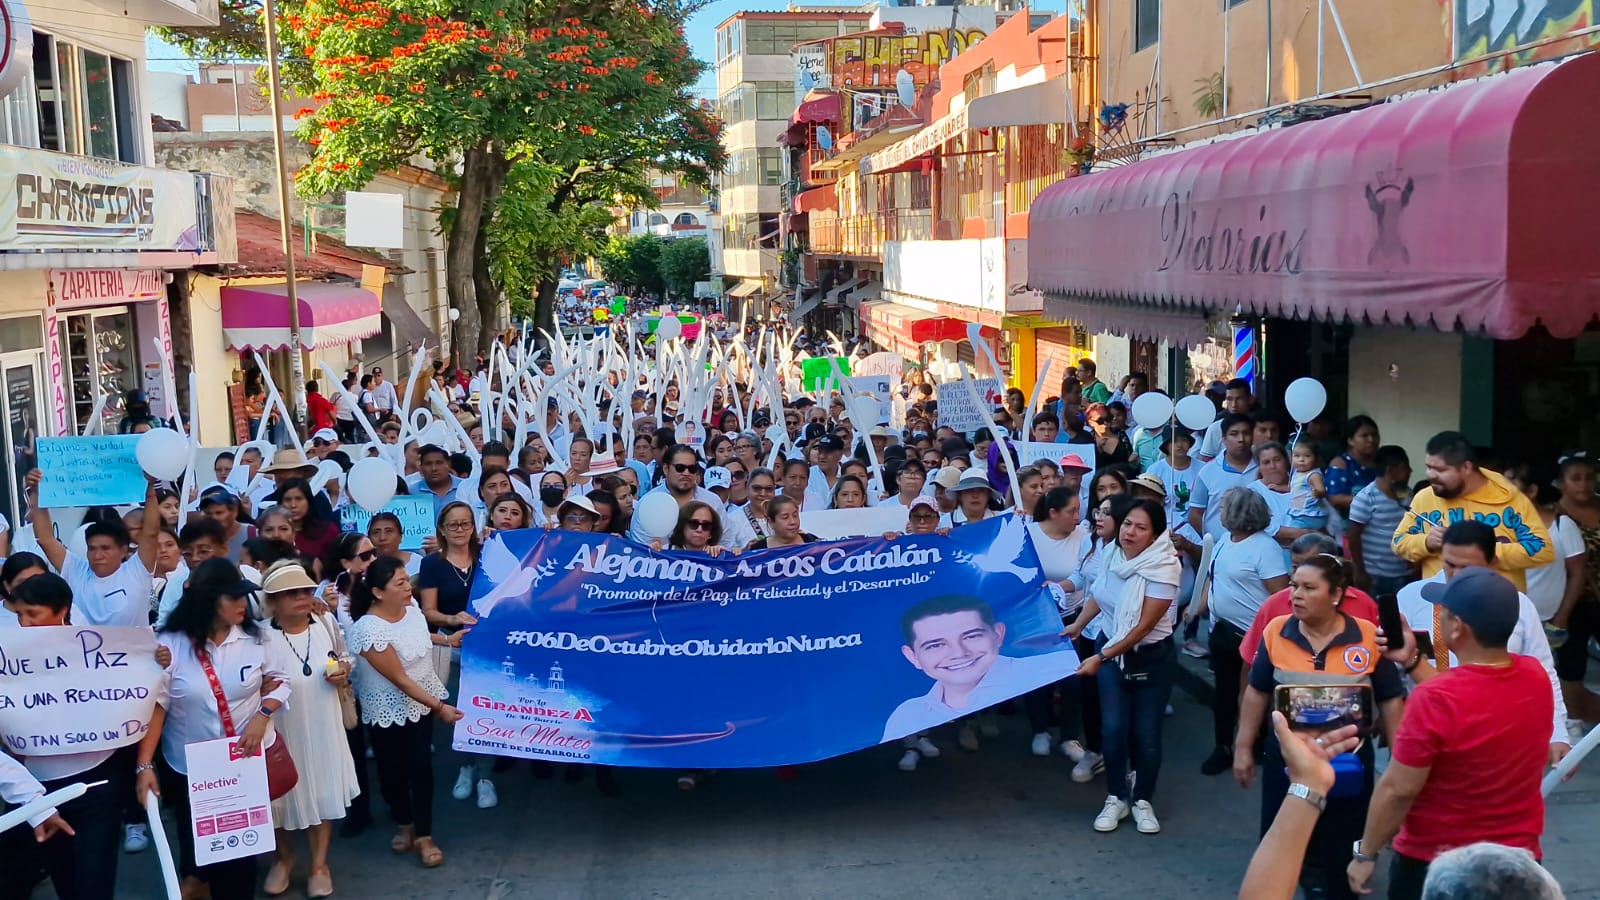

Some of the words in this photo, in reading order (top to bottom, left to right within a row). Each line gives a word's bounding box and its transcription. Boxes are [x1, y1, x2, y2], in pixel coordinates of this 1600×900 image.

[939, 112, 965, 140] JUAREZ
[17, 173, 154, 224] CHAMPIONS
[60, 271, 124, 301] ZAPATERIA
[55, 473, 65, 482] la
[709, 470, 722, 480] NY
[64, 488, 75, 497] la
[414, 501, 427, 516] la
[820, 543, 942, 575] Catalán
[664, 586, 681, 601] de
[683, 586, 698, 601] la
[701, 588, 733, 606] Paz,
[736, 587, 751, 601] la
[752, 583, 822, 600] Felicidad
[822, 586, 834, 600] y
[835, 580, 849, 593] el
[849, 570, 936, 592] Desarrollo"
[506, 630, 862, 657] #06DeOctubreOlvidarloNunca
[46, 655, 68, 670] LA
[24, 692, 58, 709] UNA
[64, 686, 149, 704] REALIDAD
[472, 695, 594, 722] GRANDEZA
[6, 734, 27, 750] NO
[30, 734, 60, 748] TAN
[65, 731, 98, 744] SOLO
[103, 730, 119, 741] UN
[467, 717, 514, 739] San
[520, 722, 592, 750] Mateo
[509, 743, 524, 752] DE
[525, 746, 591, 760] DESARROLLO
[191, 776, 238, 792] Selective
